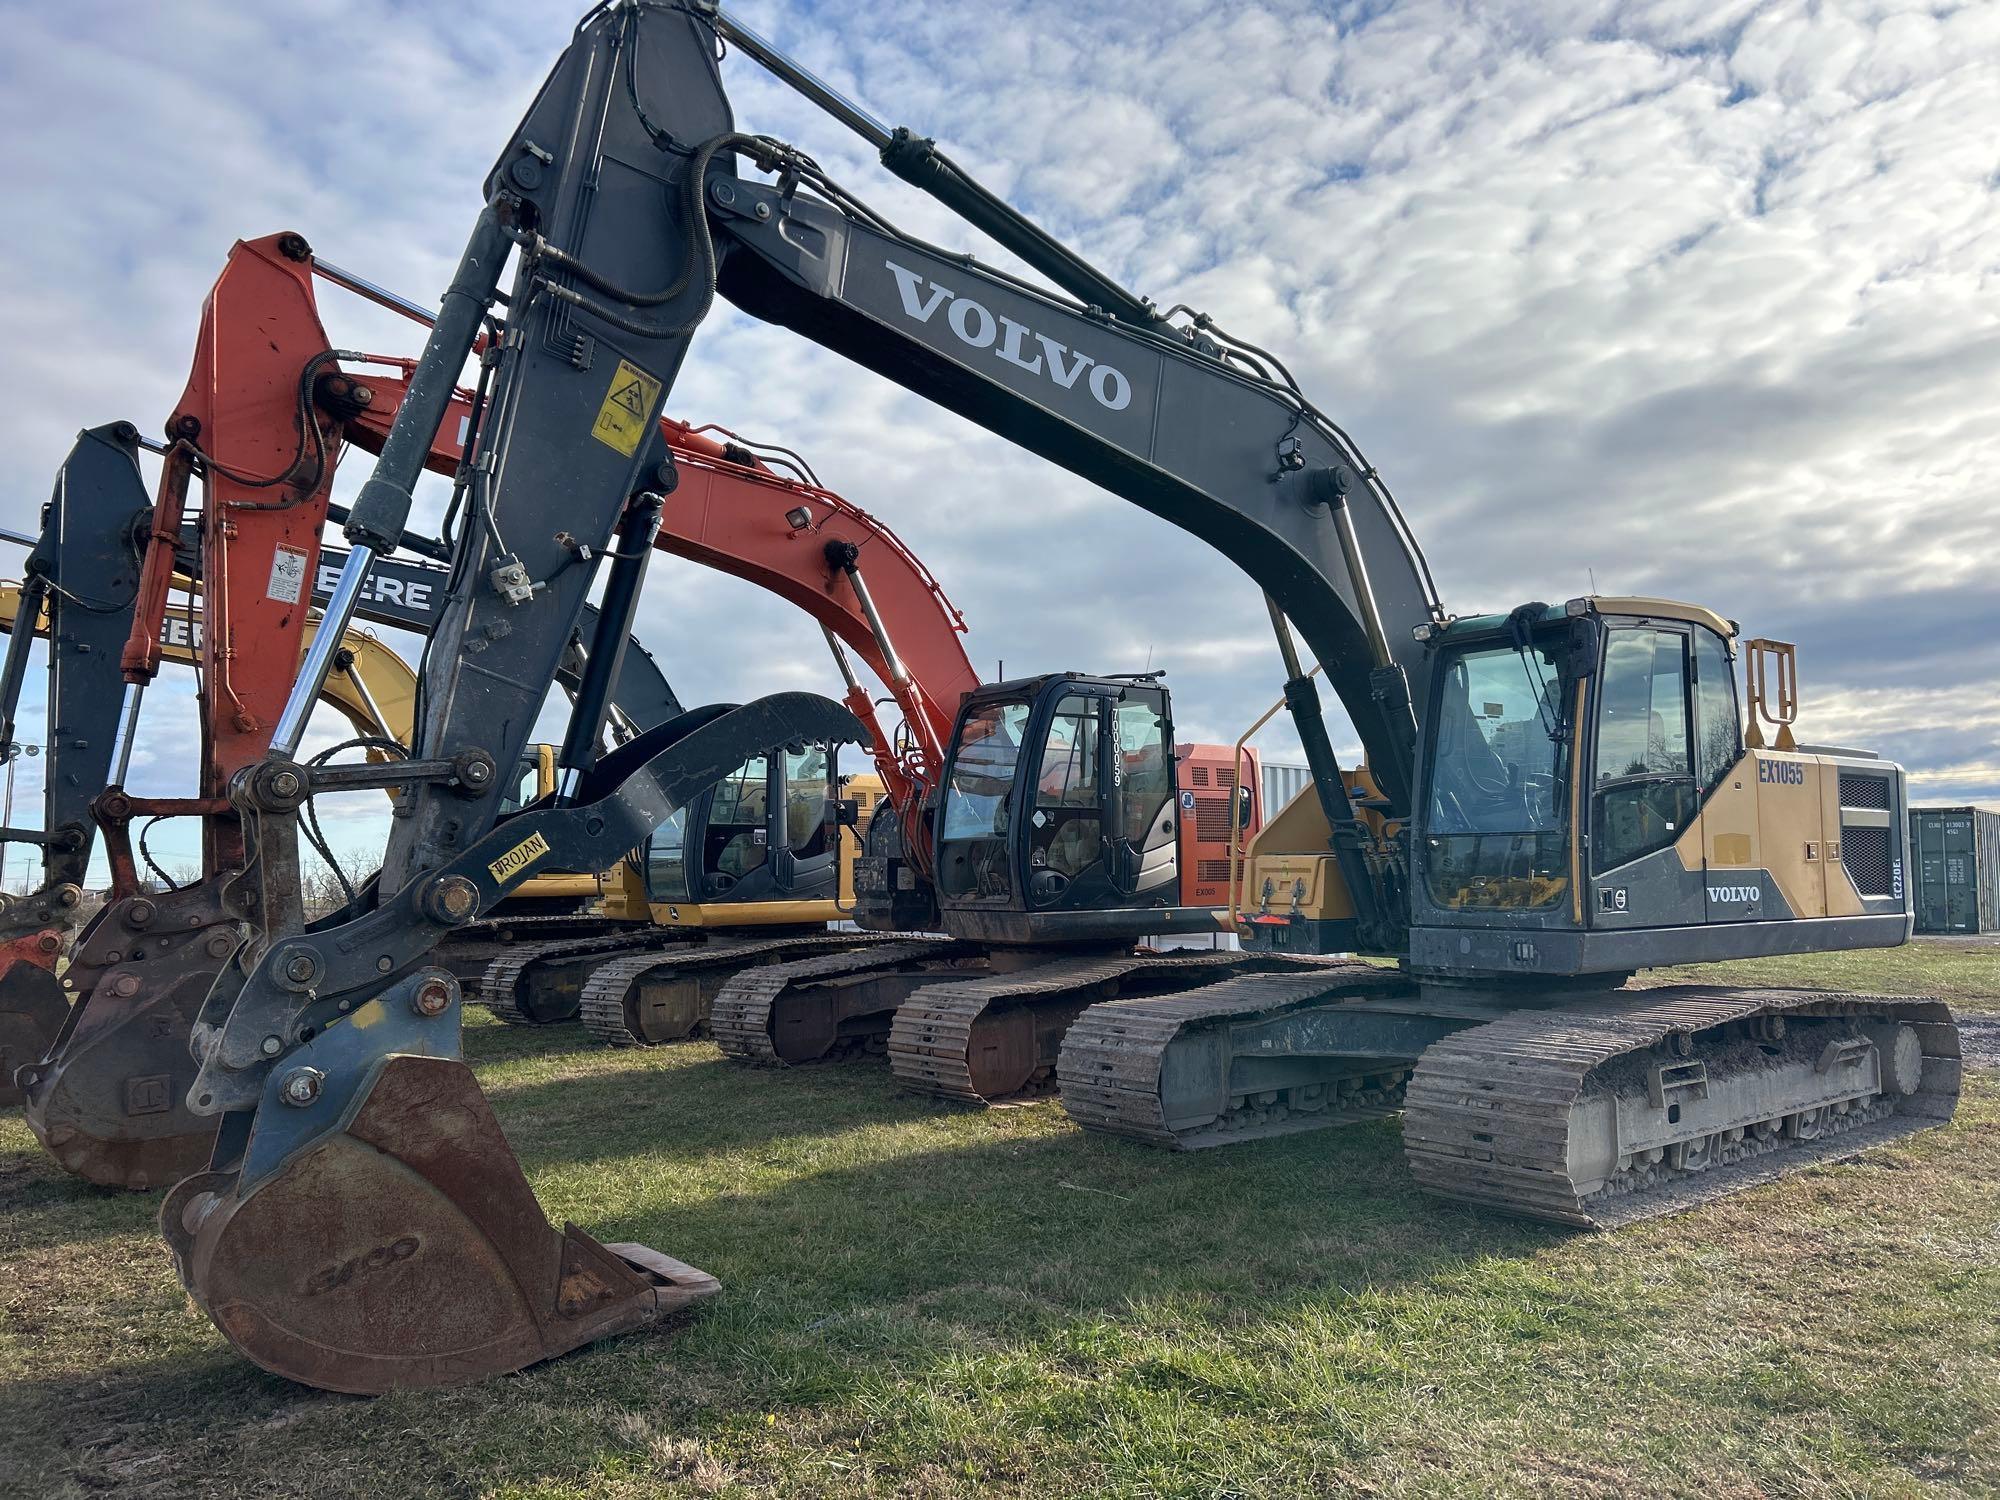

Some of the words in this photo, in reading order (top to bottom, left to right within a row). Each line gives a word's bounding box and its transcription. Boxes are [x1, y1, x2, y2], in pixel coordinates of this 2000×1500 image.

[885, 260, 1132, 411] VOLVO
[1112, 708, 1120, 787] 7000059
[1759, 759, 1803, 785] EX1055
[492, 836, 544, 876] TROJAN
[1195, 887, 1216, 897] EX005
[1707, 886, 1760, 903] VOLVO
